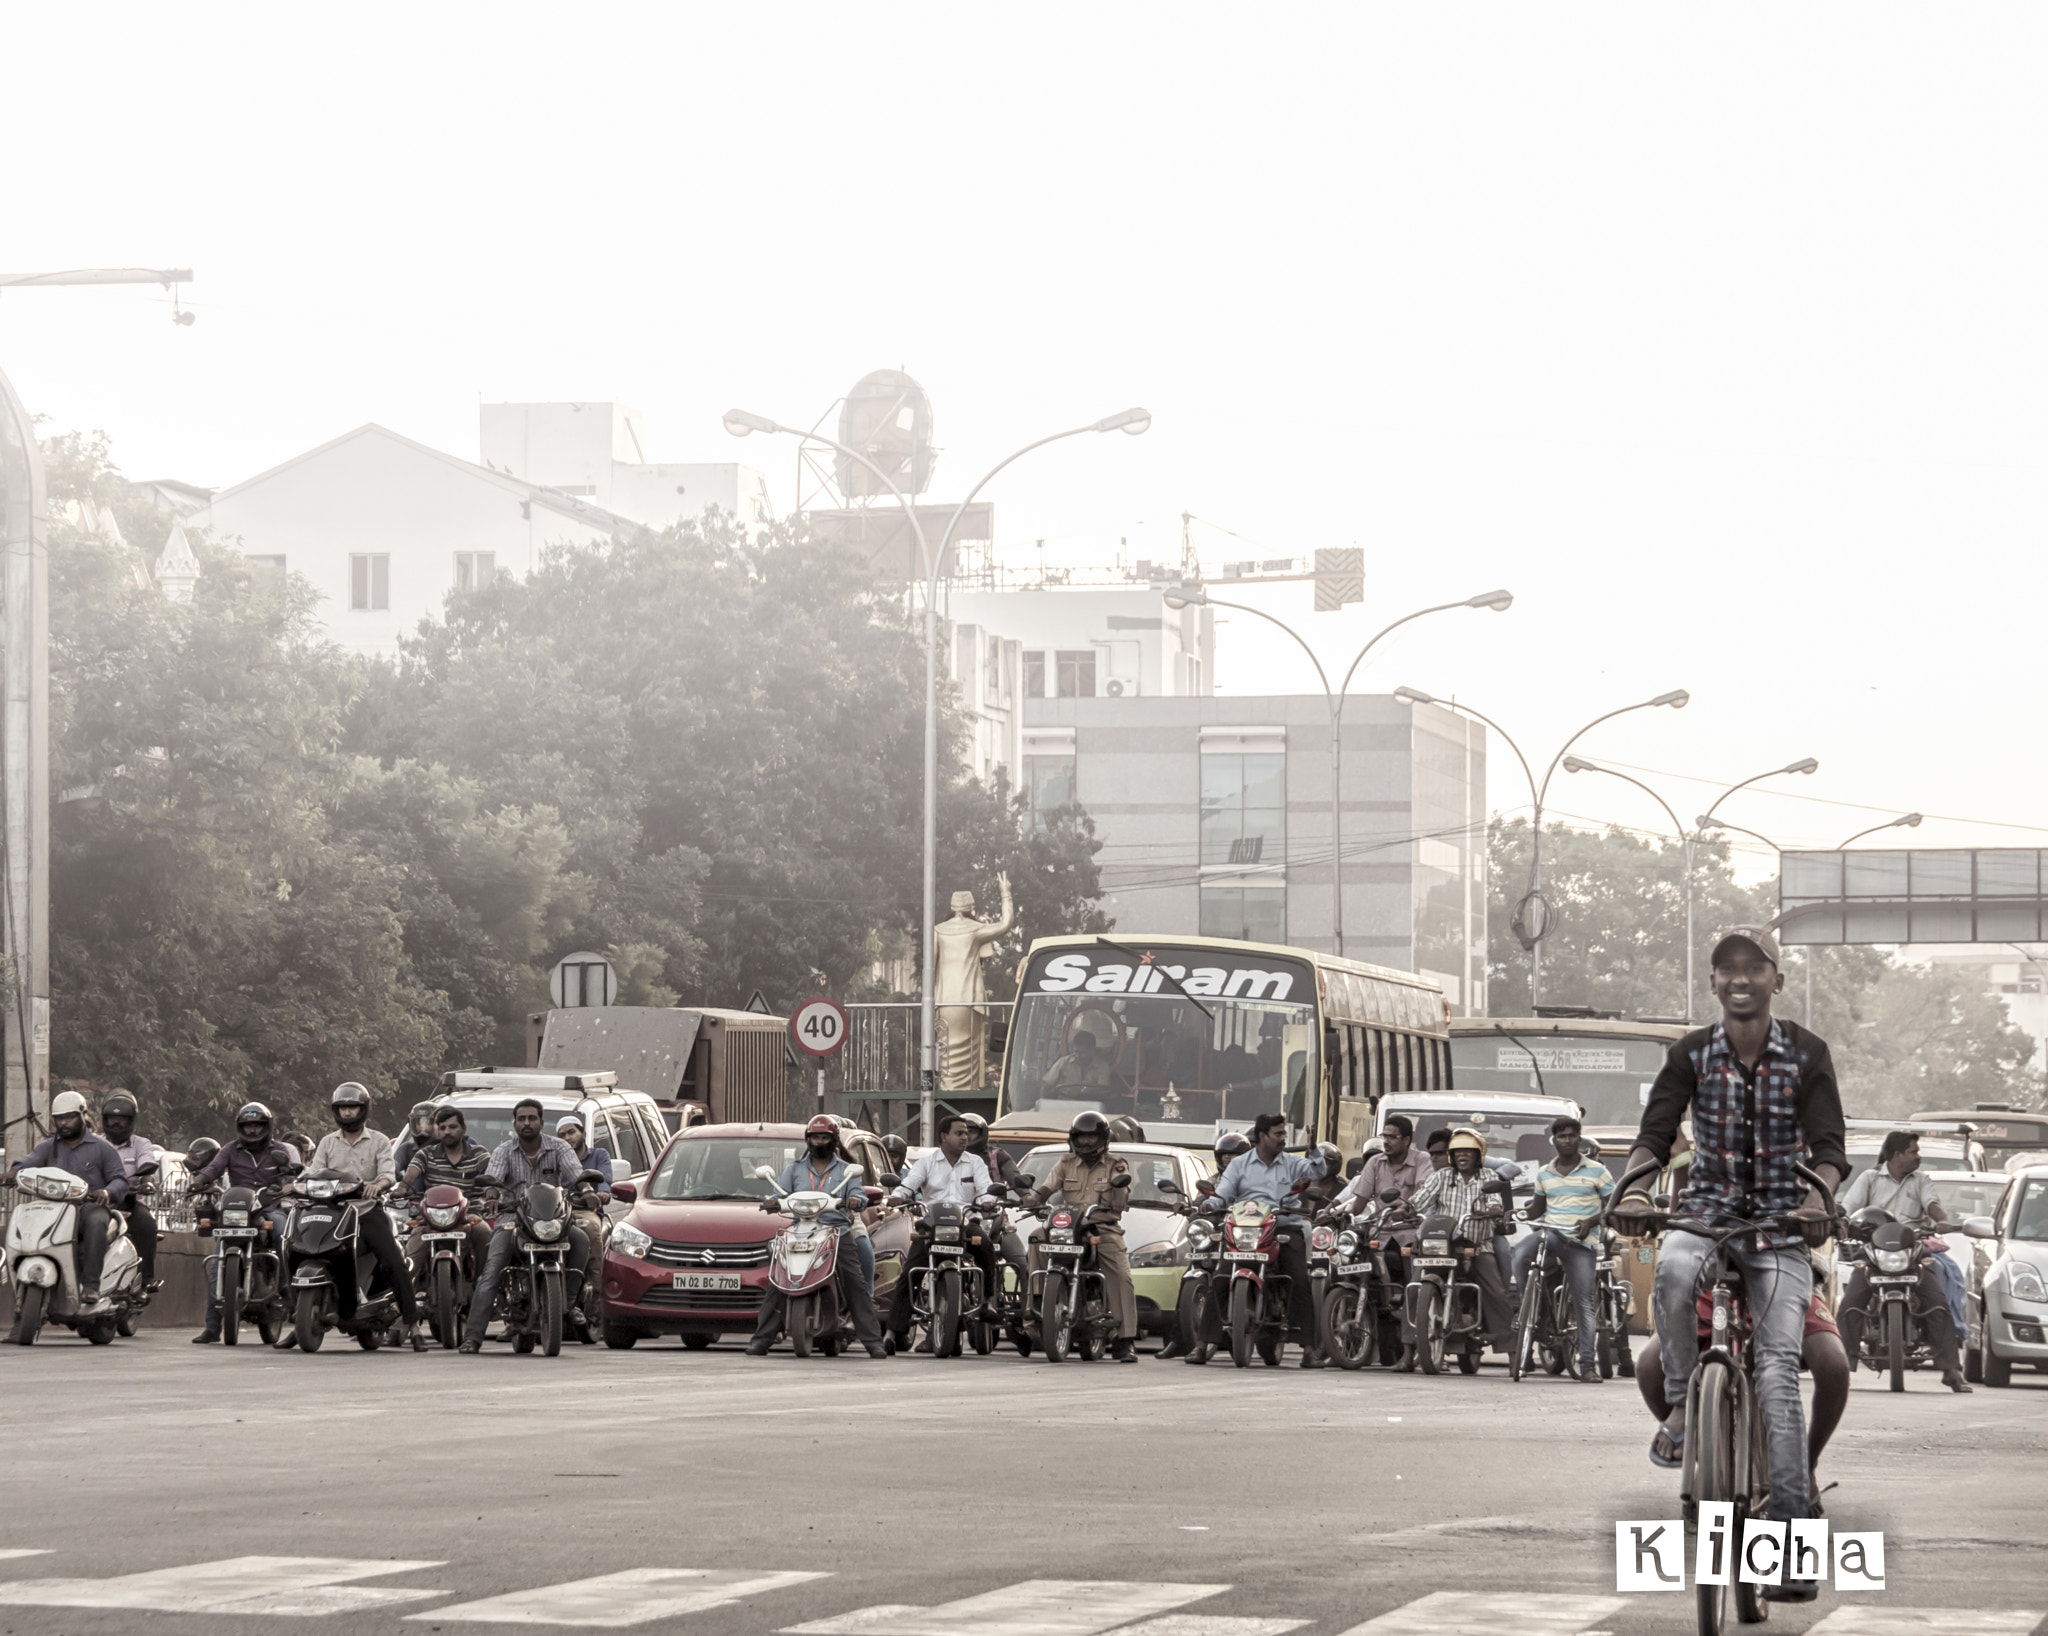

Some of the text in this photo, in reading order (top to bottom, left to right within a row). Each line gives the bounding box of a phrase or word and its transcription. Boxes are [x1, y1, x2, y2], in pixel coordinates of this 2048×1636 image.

[1039, 954, 1293, 999] Sairam
[804, 1015, 836, 1038] 40
[675, 1276, 739, 1289] TN 02 BC 7708
